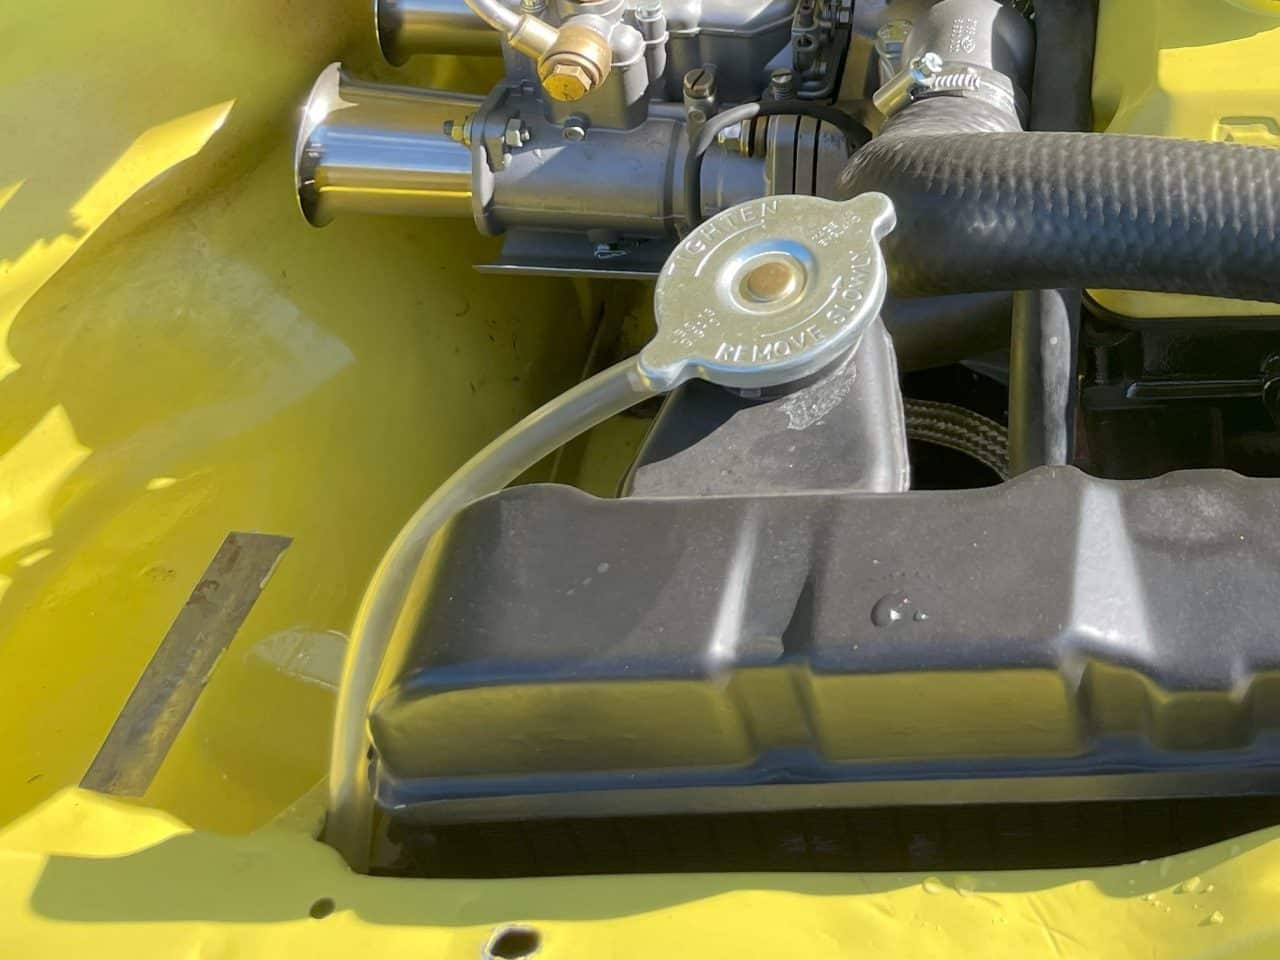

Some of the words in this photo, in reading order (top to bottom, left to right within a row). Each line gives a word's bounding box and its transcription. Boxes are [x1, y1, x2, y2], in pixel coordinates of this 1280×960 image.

[667, 199, 779, 276] TIGHTEN
[715, 324, 827, 363] REMOVE
[826, 249, 873, 325] SLOWLY
